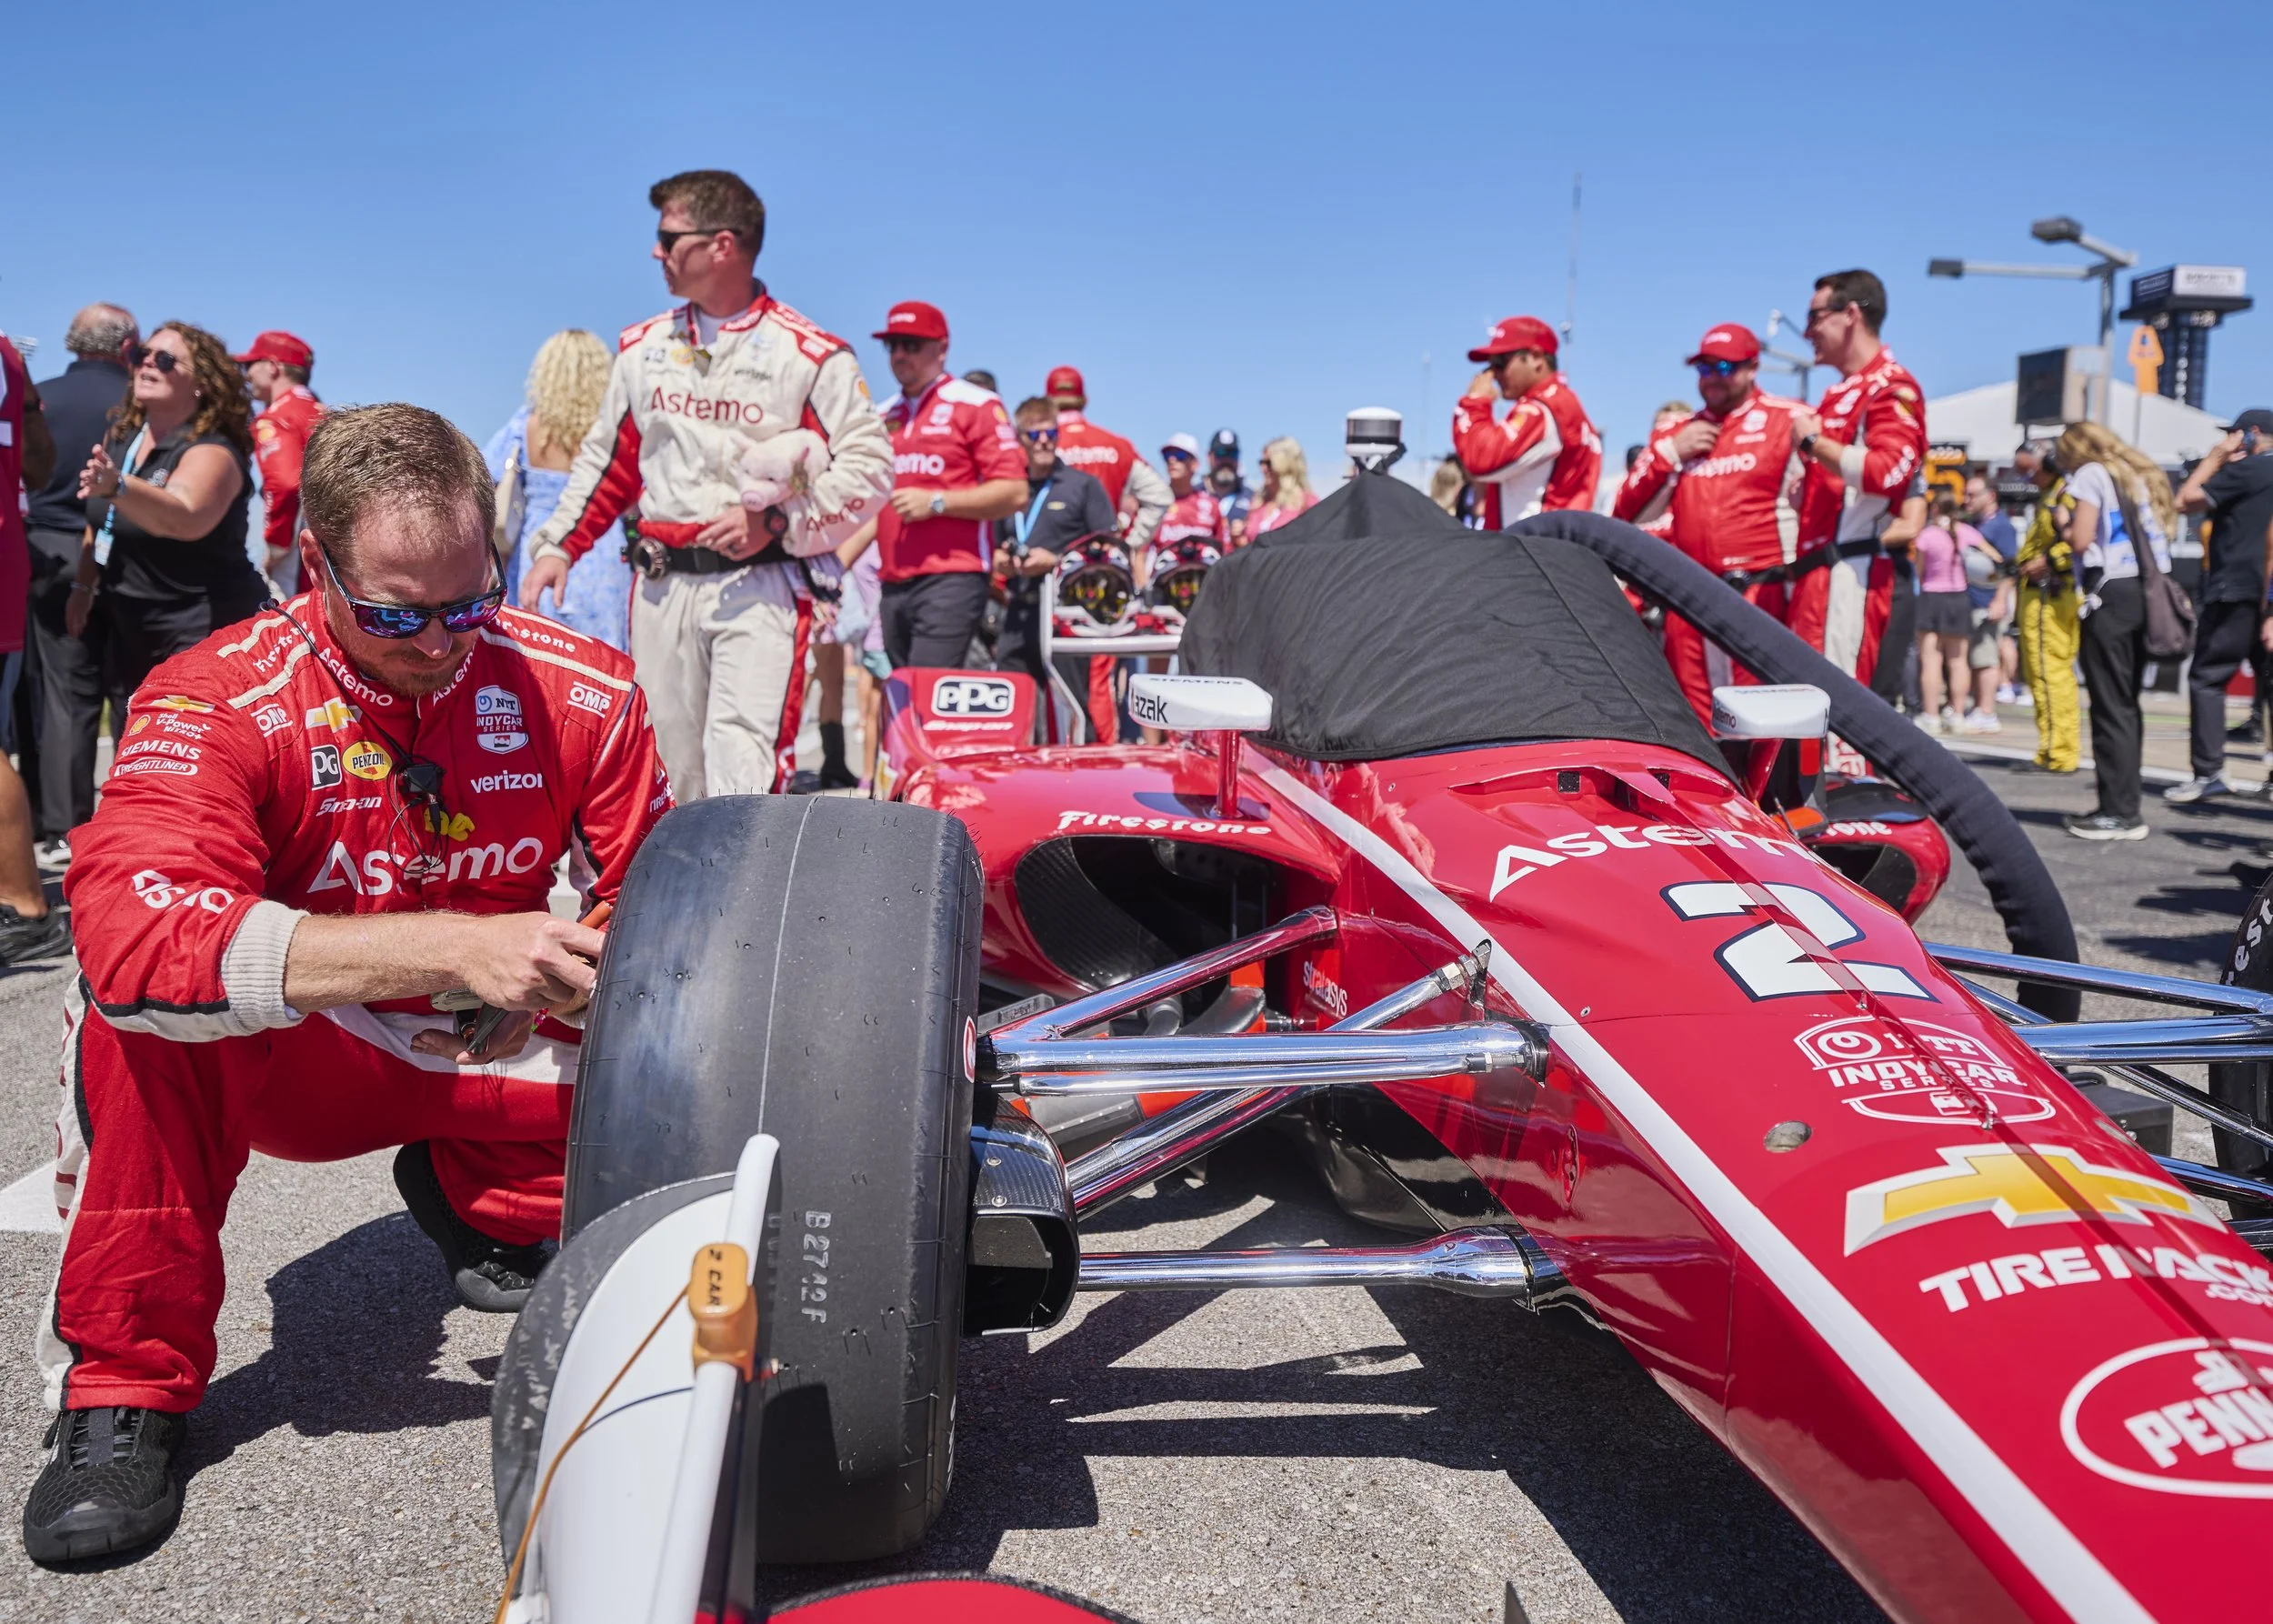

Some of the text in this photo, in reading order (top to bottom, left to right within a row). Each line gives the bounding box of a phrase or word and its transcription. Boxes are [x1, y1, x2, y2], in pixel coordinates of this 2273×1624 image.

[651, 386, 764, 424] Astemo
[319, 647, 394, 707] Astemo
[569, 686, 610, 712] OMP
[937, 682, 1010, 713] PPG
[1131, 692, 1169, 724] azak
[156, 718, 205, 733] V-Power
[476, 715, 523, 727] INDYCAR
[118, 739, 202, 760] SIEMENS
[120, 759, 188, 775] FREIGHTLINER
[1057, 809, 1272, 835] Firestone
[1489, 823, 1821, 903] Astem
[1659, 879, 1941, 1004] 2
[1303, 960, 1348, 1017] stratasys
